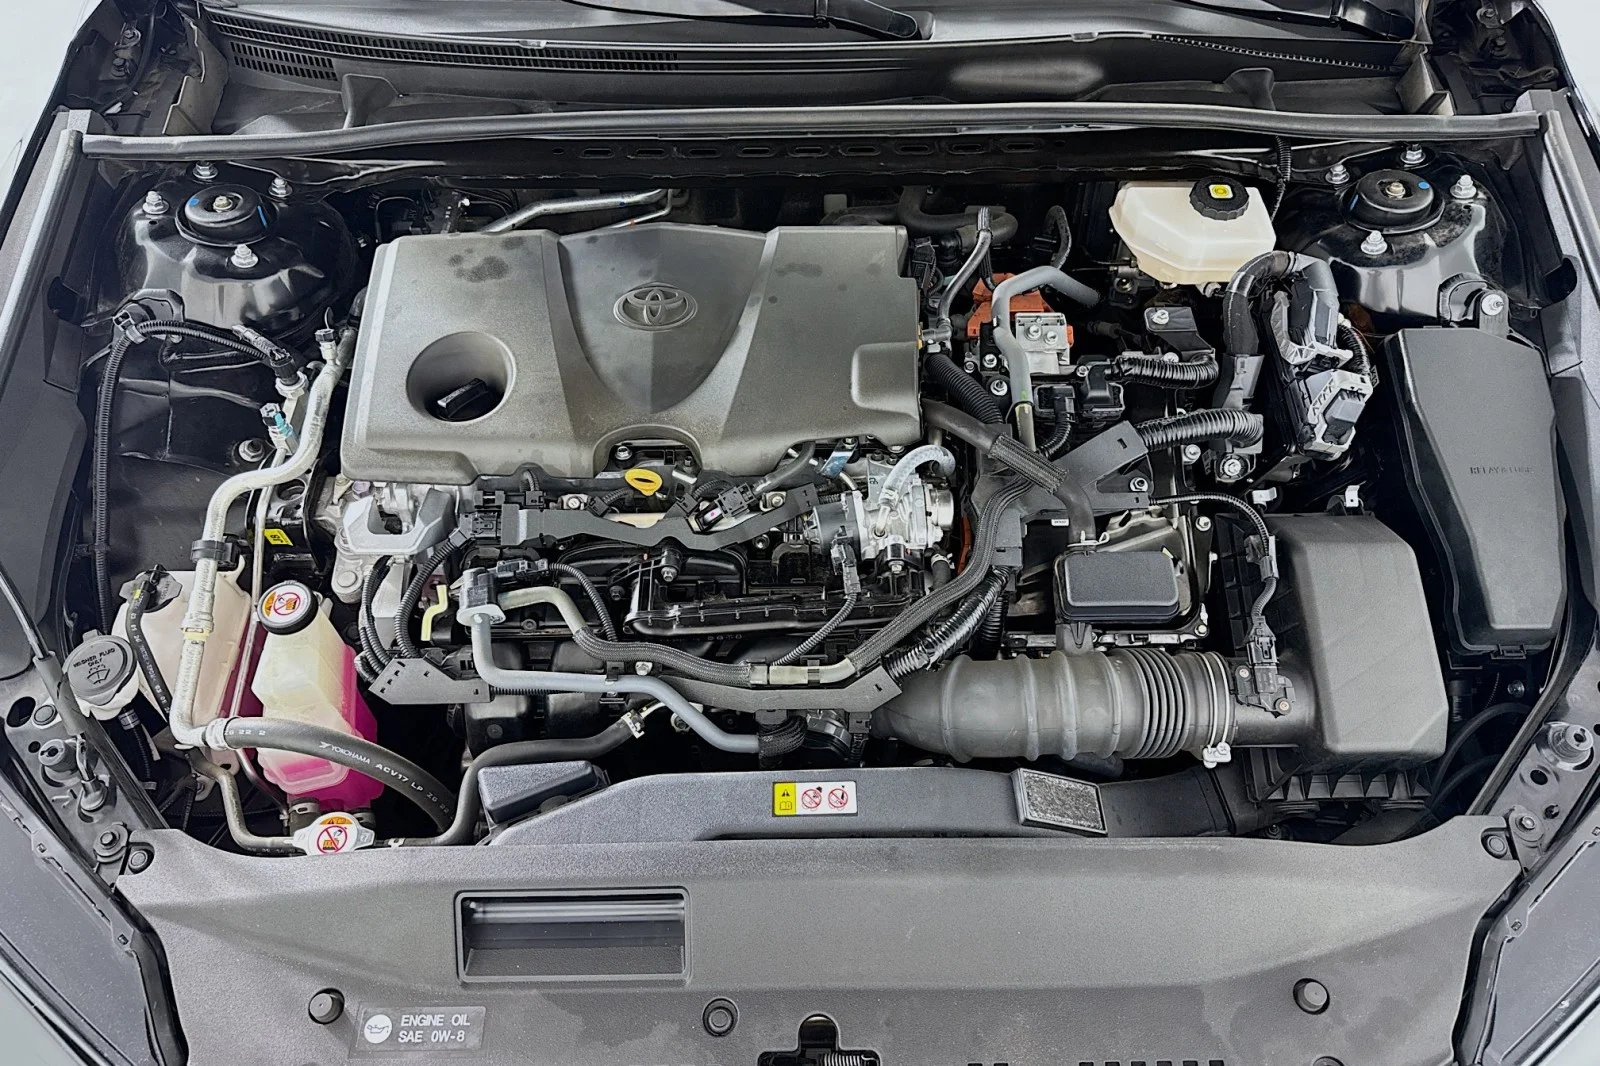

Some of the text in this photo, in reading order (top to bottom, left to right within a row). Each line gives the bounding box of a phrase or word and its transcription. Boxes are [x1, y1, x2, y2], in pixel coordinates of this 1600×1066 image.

[99, 648, 116, 658] FLUID
[88, 658, 103, 667] ONLY
[331, 745, 371, 764] YOKOHAMA
[375, 763, 410, 782] ACV17
[411, 781, 424, 792] LP
[400, 1014, 471, 1027] ENGINE OIL
[398, 1030, 465, 1043] SAE 0W-8
